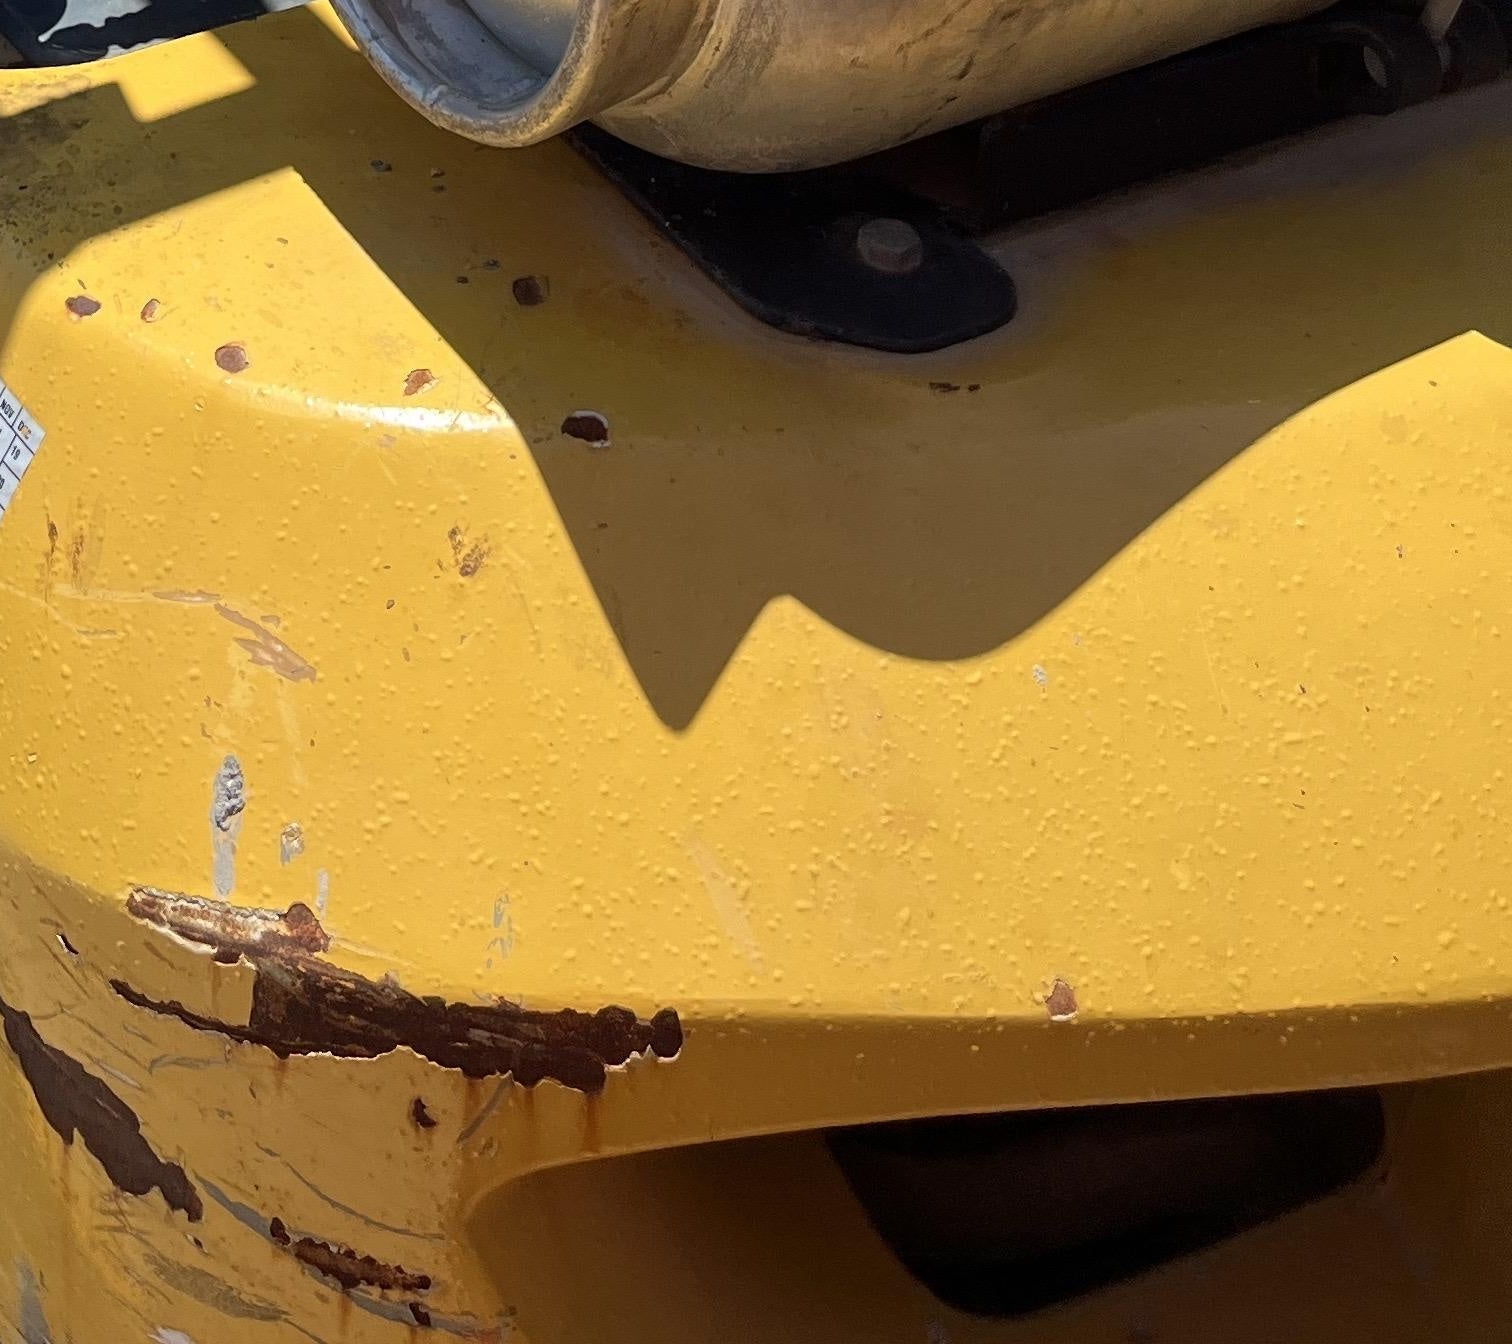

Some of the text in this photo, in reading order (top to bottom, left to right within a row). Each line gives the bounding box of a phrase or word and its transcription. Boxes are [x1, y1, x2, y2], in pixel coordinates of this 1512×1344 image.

[0, 396, 15, 421] NOV
[17, 418, 31, 442] DC
[10, 443, 21, 462] 19
